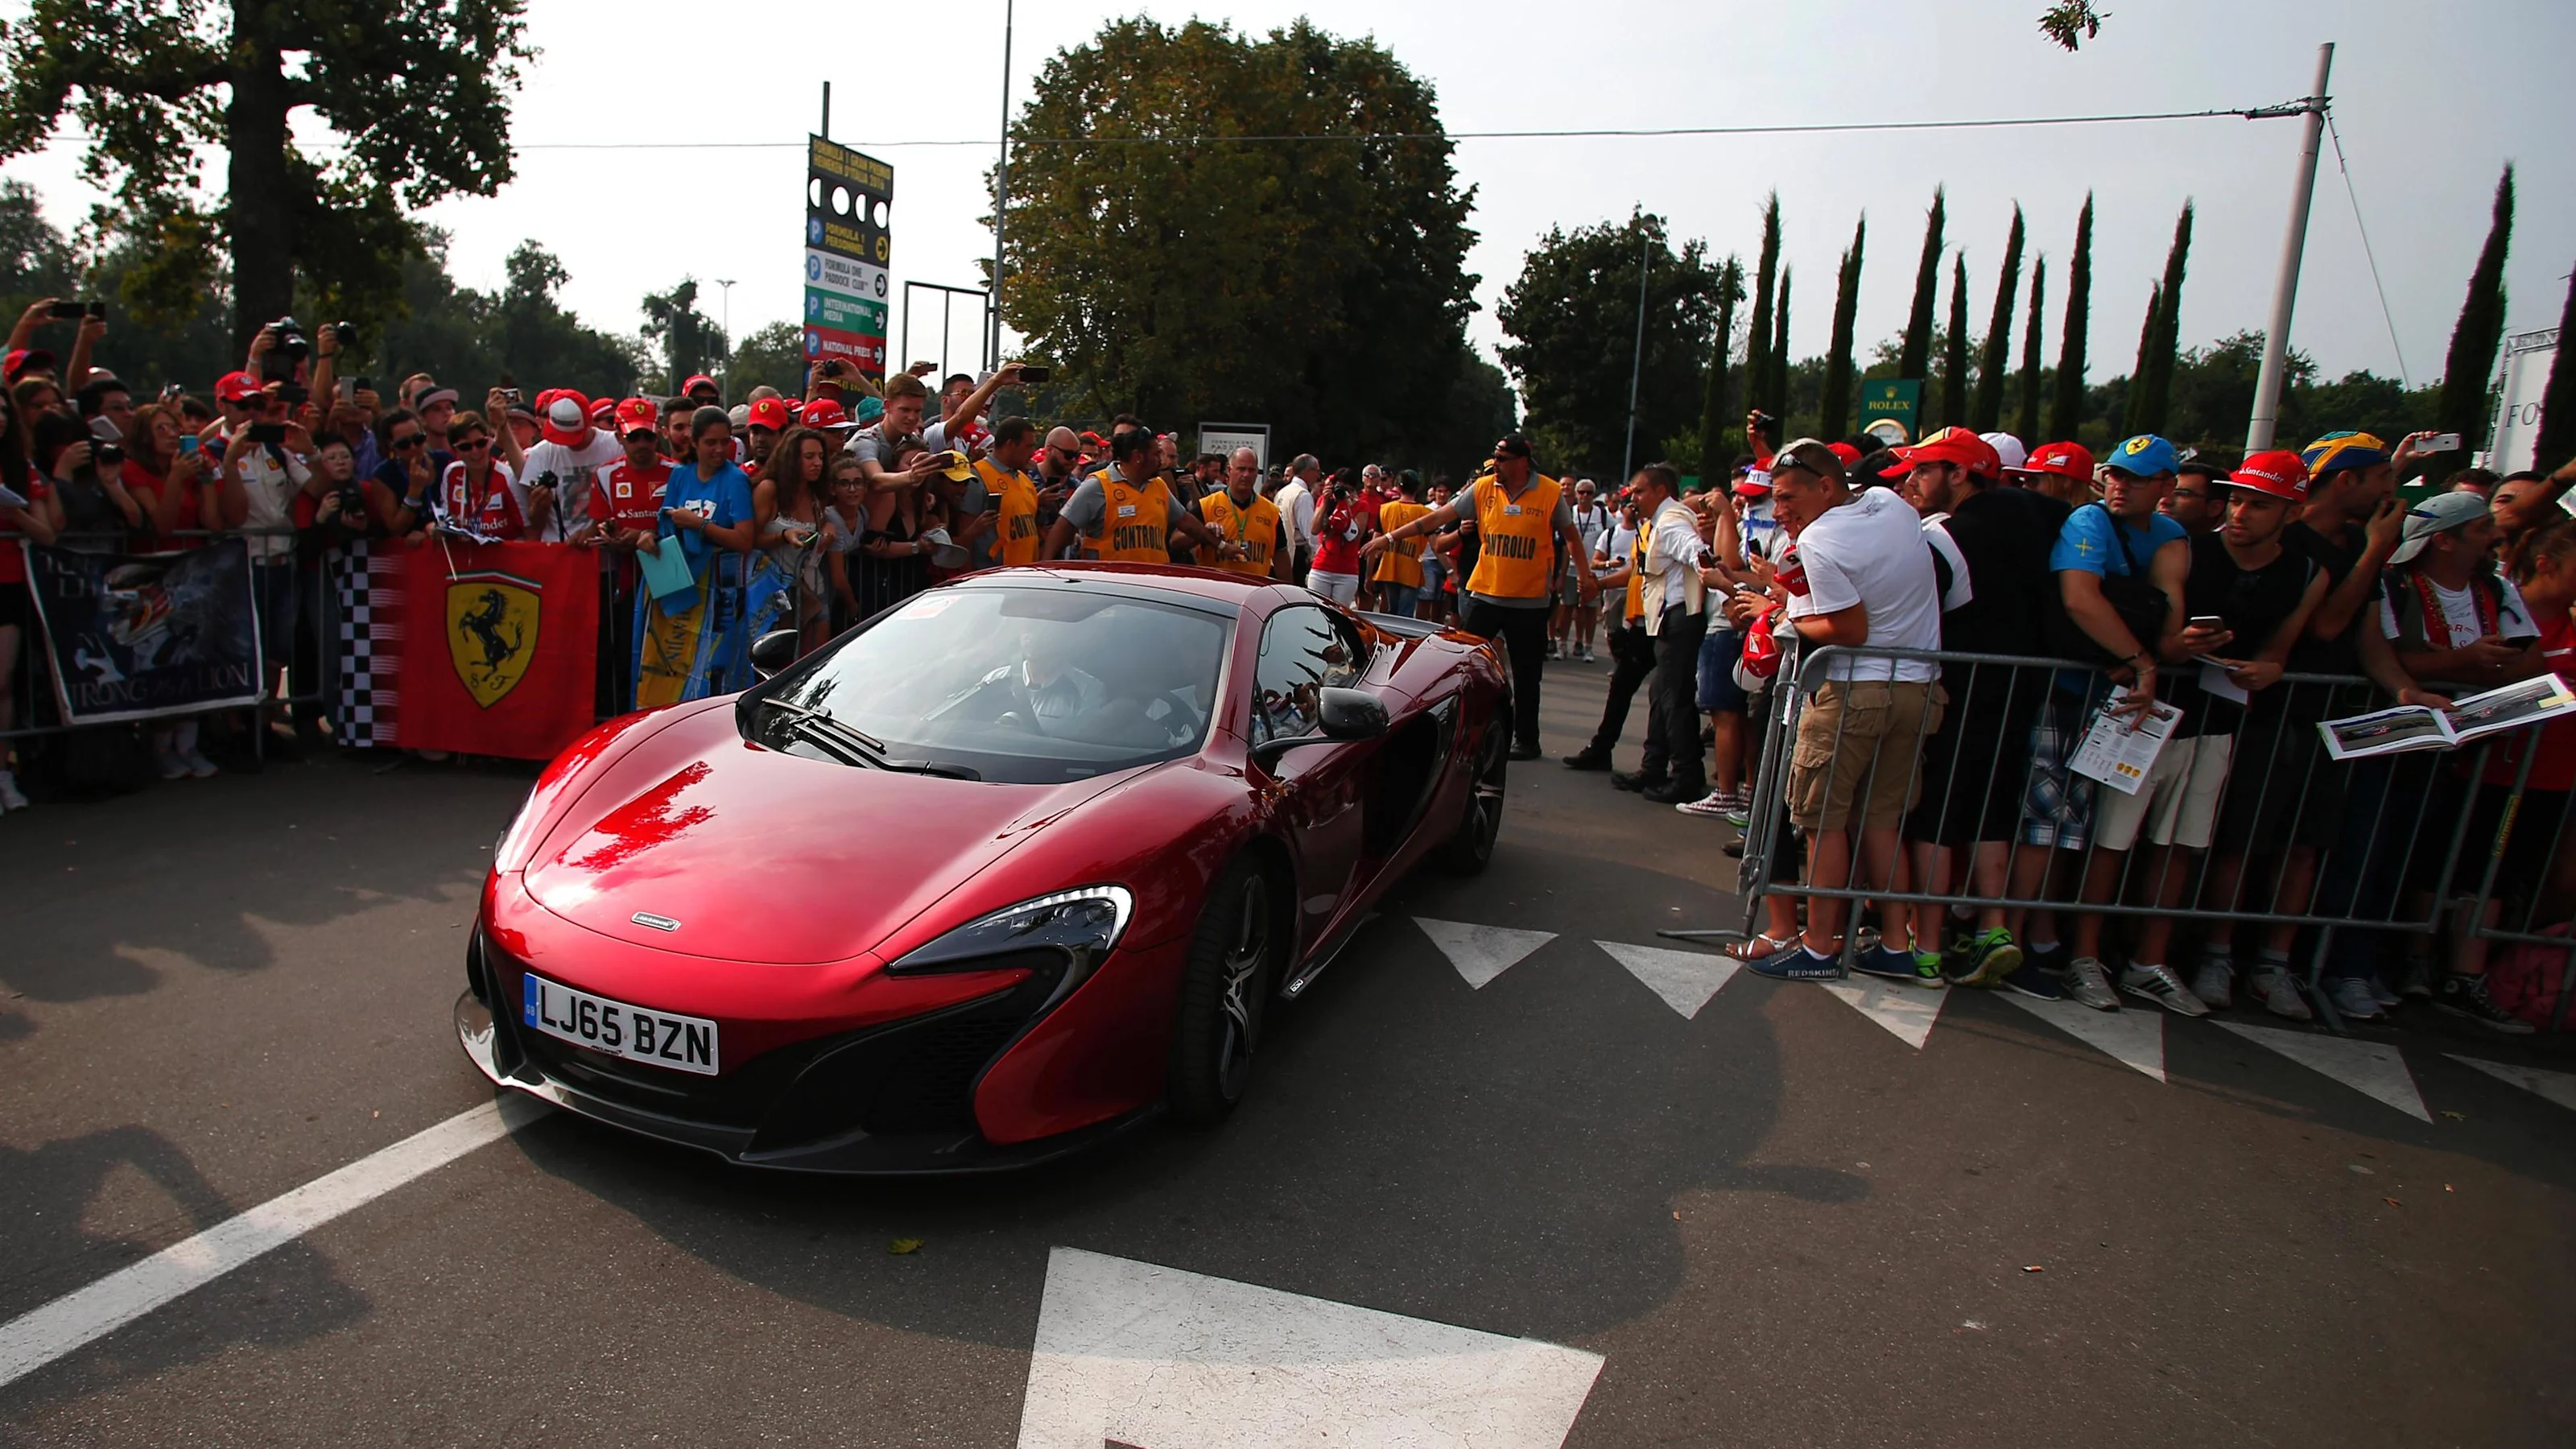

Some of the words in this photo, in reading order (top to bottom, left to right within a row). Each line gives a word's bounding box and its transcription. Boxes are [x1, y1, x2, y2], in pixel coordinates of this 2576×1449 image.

[811, 220, 821, 240] P
[825, 221, 859, 242] FORMULA
[825, 233, 865, 256] PERSONNEL
[810, 258, 819, 277] P
[824, 258, 850, 275] FORMULA
[824, 271, 850, 288] PADDOCK
[809, 296, 818, 315] P
[823, 296, 873, 318] INTERNATIONAL
[823, 308, 844, 324] MEDIA
[808, 333, 818, 353] P
[823, 340, 853, 356] NATIONAL
[853, 345, 871, 358] PRESS
[1868, 400, 1910, 411] ROLEX
[2505, 402, 2544, 427] FO
[2244, 466, 2285, 484] Santander
[626, 508, 659, 518] Santan
[1009, 514, 1038, 540] CONT
[68, 676, 148, 708] TRONG
[526, 1003, 536, 1017] GB
[540, 985, 622, 1046] LJ65
[633, 1013, 712, 1067] BZN
